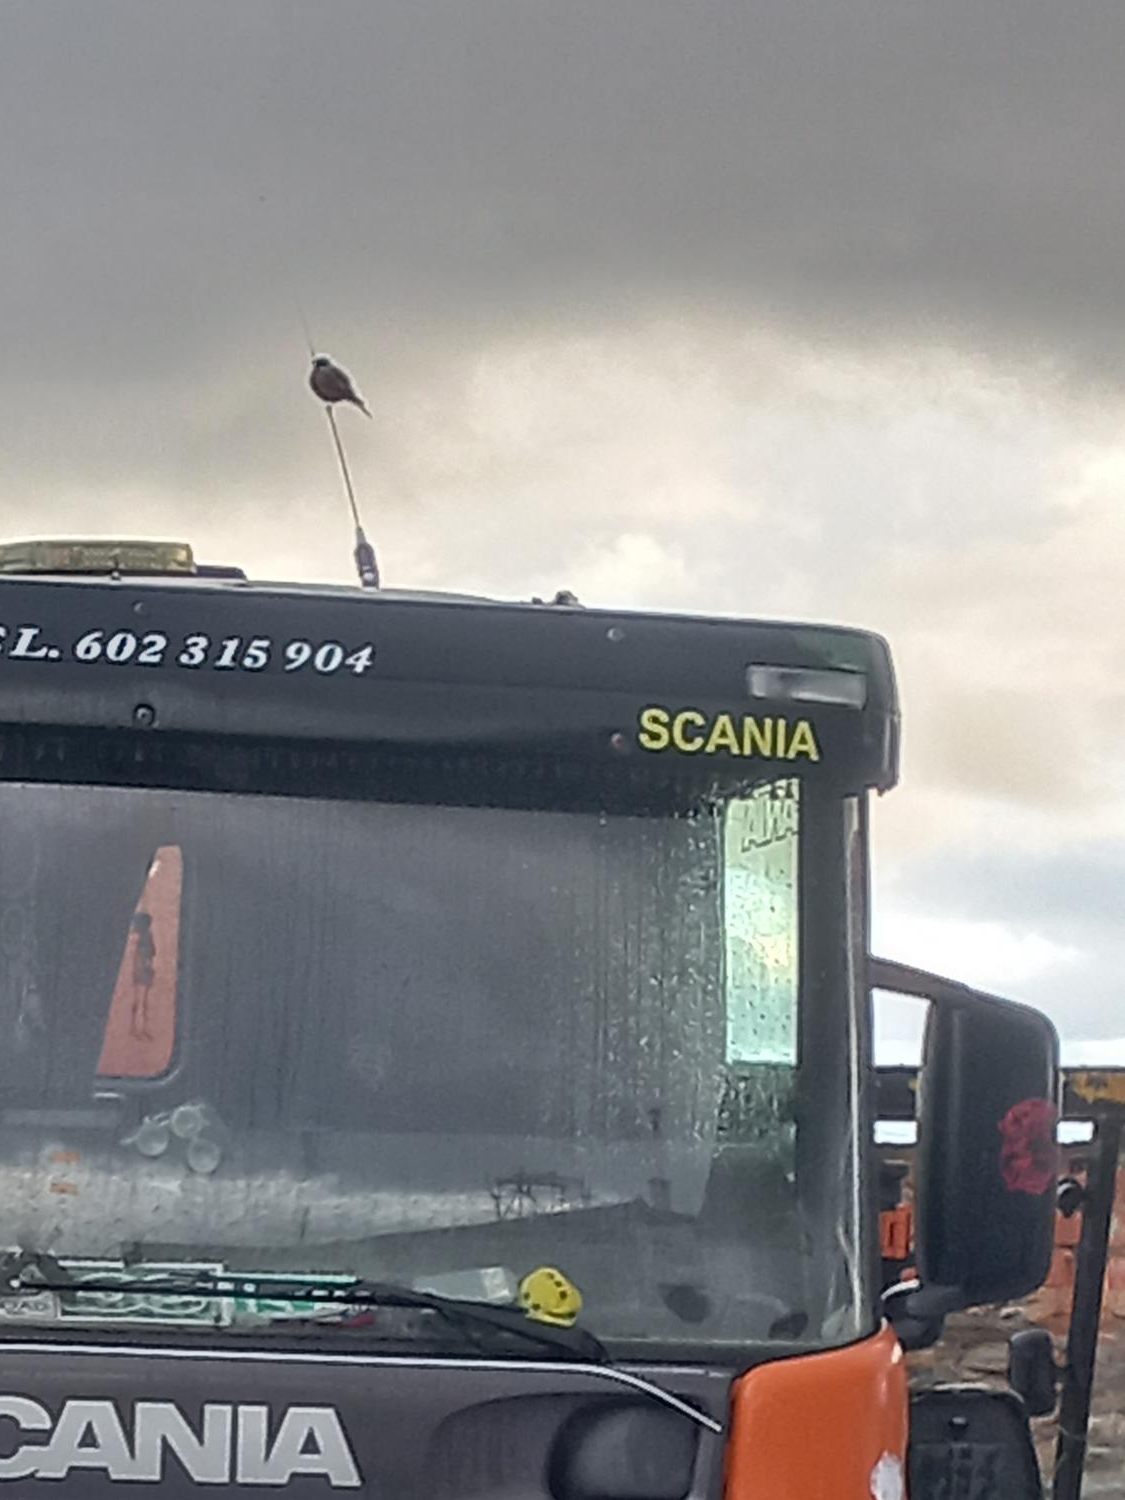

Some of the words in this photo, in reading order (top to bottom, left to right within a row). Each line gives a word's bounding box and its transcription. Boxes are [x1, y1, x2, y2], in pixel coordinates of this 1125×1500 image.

[75, 631, 168, 663] 602
[179, 635, 271, 669] 315
[284, 641, 373, 673] 904
[638, 707, 820, 762] SCANIA
